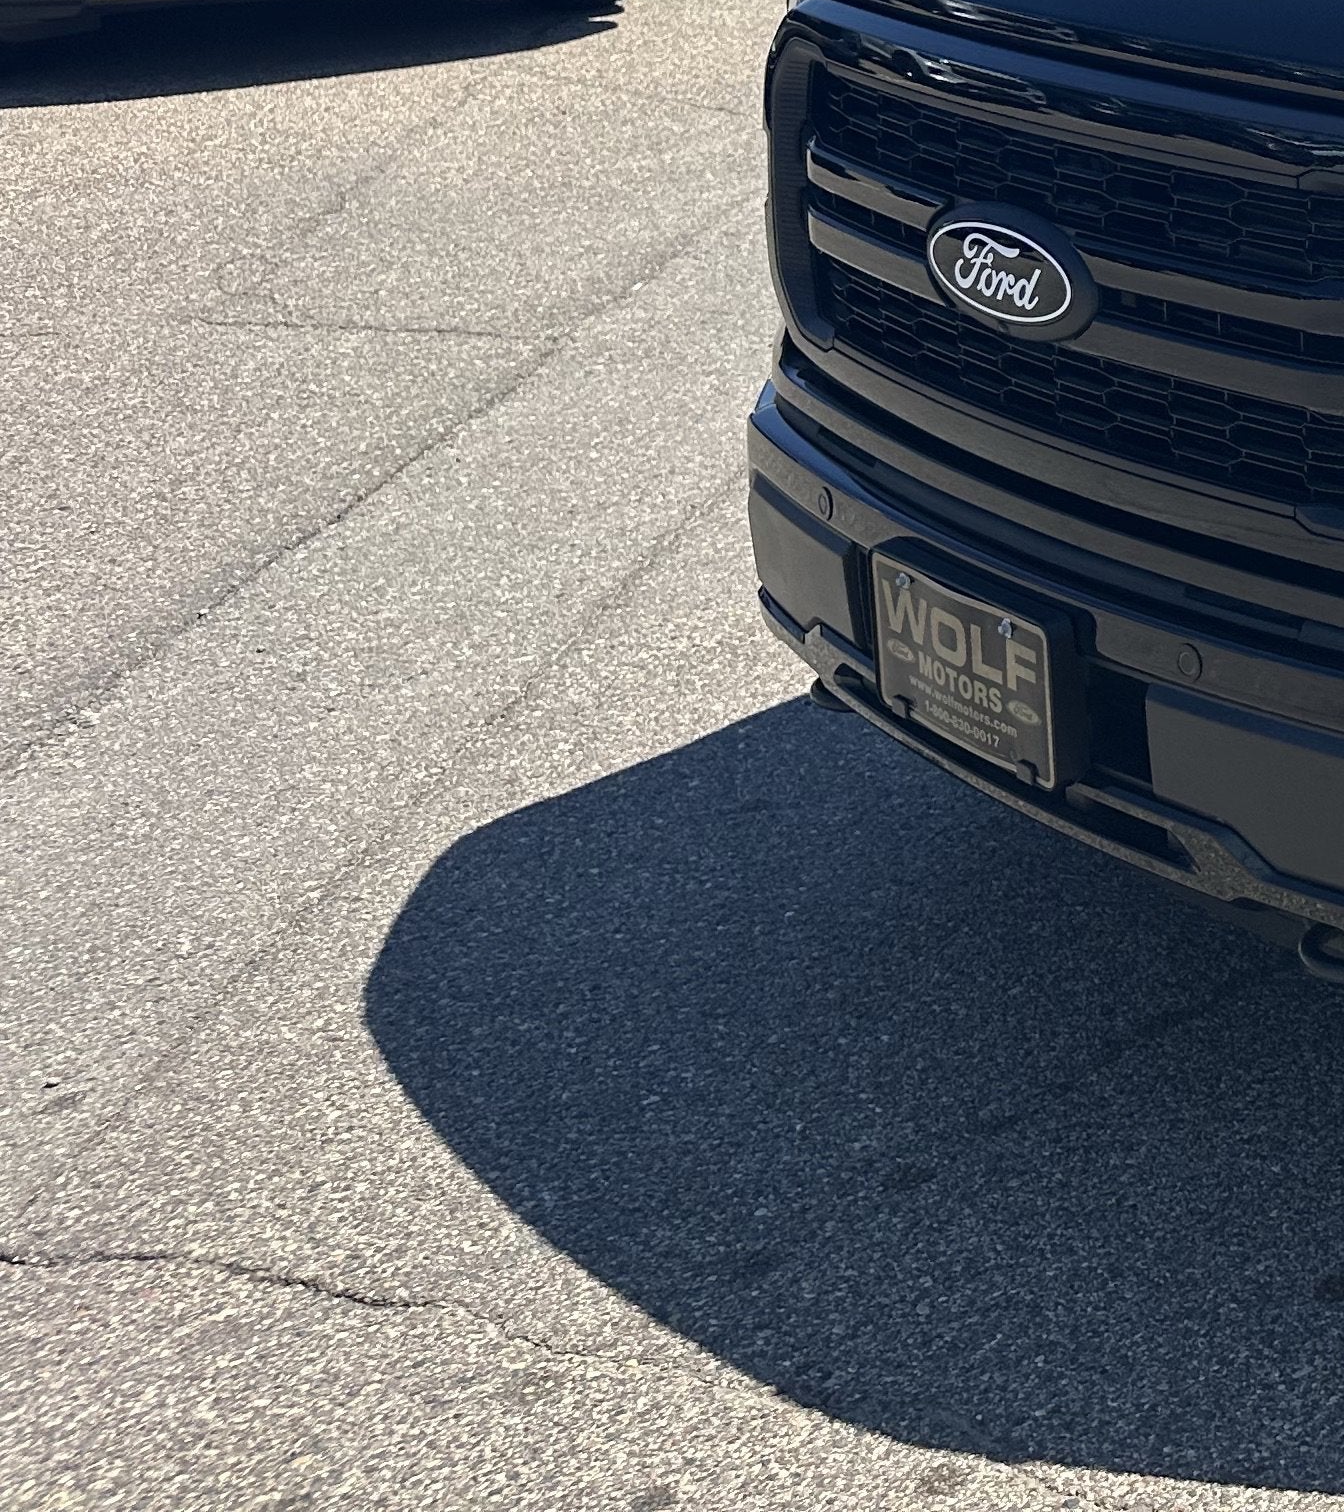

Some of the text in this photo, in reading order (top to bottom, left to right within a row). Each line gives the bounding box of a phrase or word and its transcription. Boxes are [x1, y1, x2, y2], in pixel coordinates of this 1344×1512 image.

[954, 232, 1042, 310] Ford
[881, 579, 1037, 692] WOLF
[917, 650, 1004, 714] MOTORS
